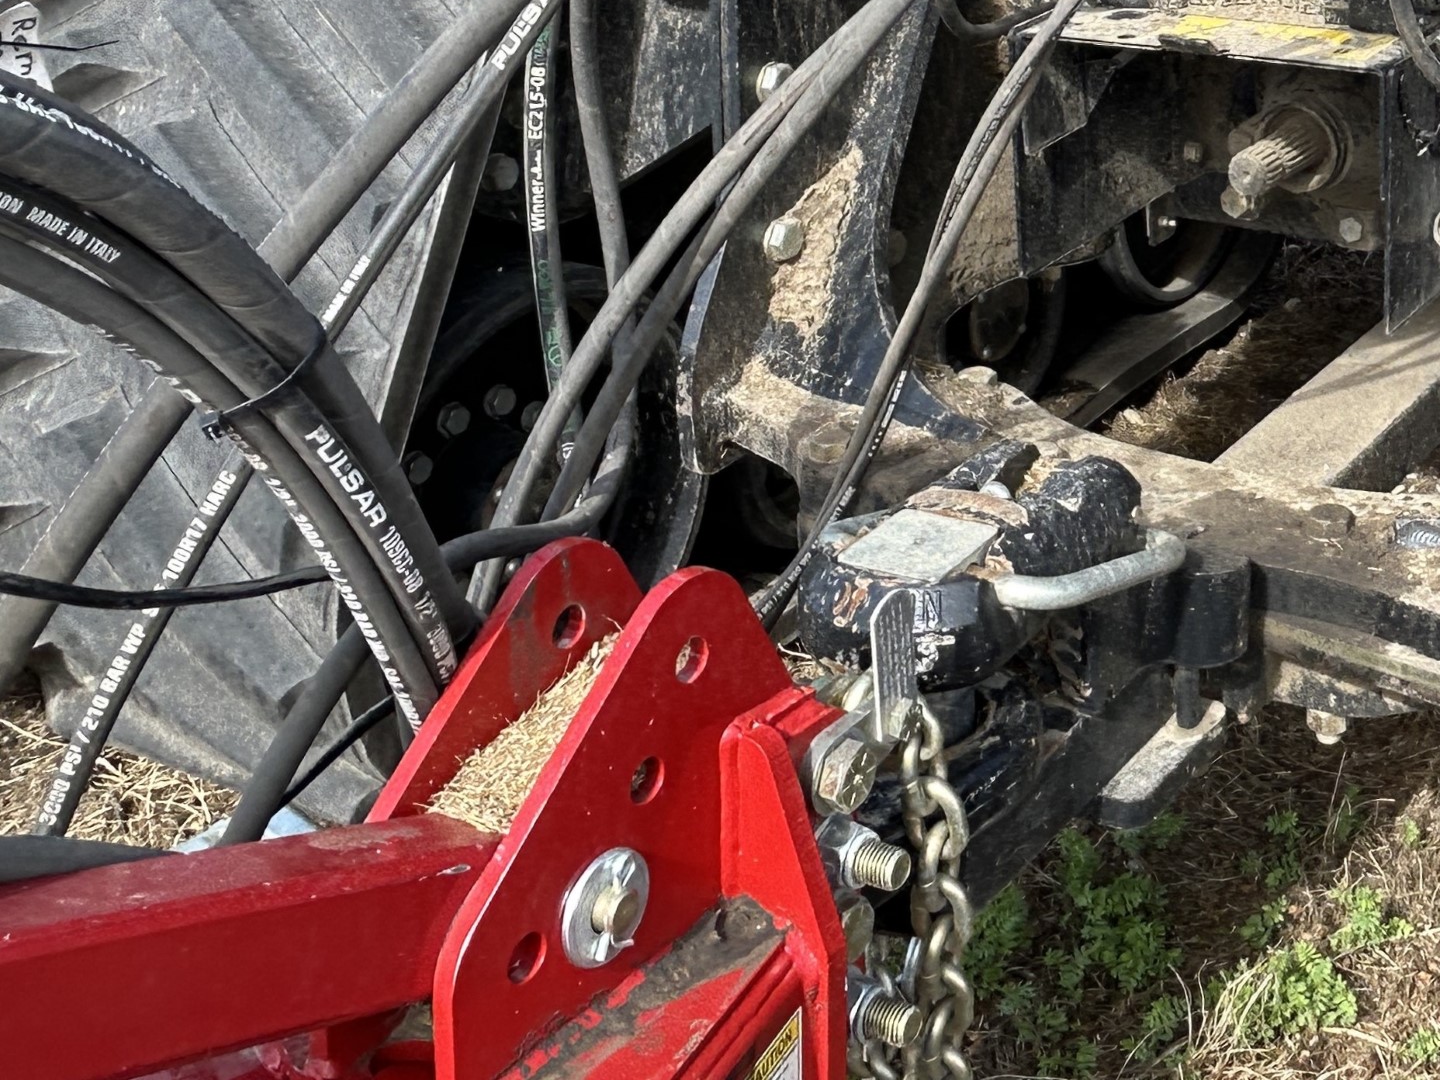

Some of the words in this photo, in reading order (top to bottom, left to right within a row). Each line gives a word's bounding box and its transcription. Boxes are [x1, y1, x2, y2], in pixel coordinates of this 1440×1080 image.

[26, 206, 70, 236] MADE
[84, 237, 121, 263] ITALY
[304, 423, 388, 528] PULSAR
[82, 695, 110, 731] 210
[100, 655, 131, 694] BAR
[120, 623, 146, 656] WP
[162, 517, 208, 581] 100R17
[200, 470, 237, 517] HARC
